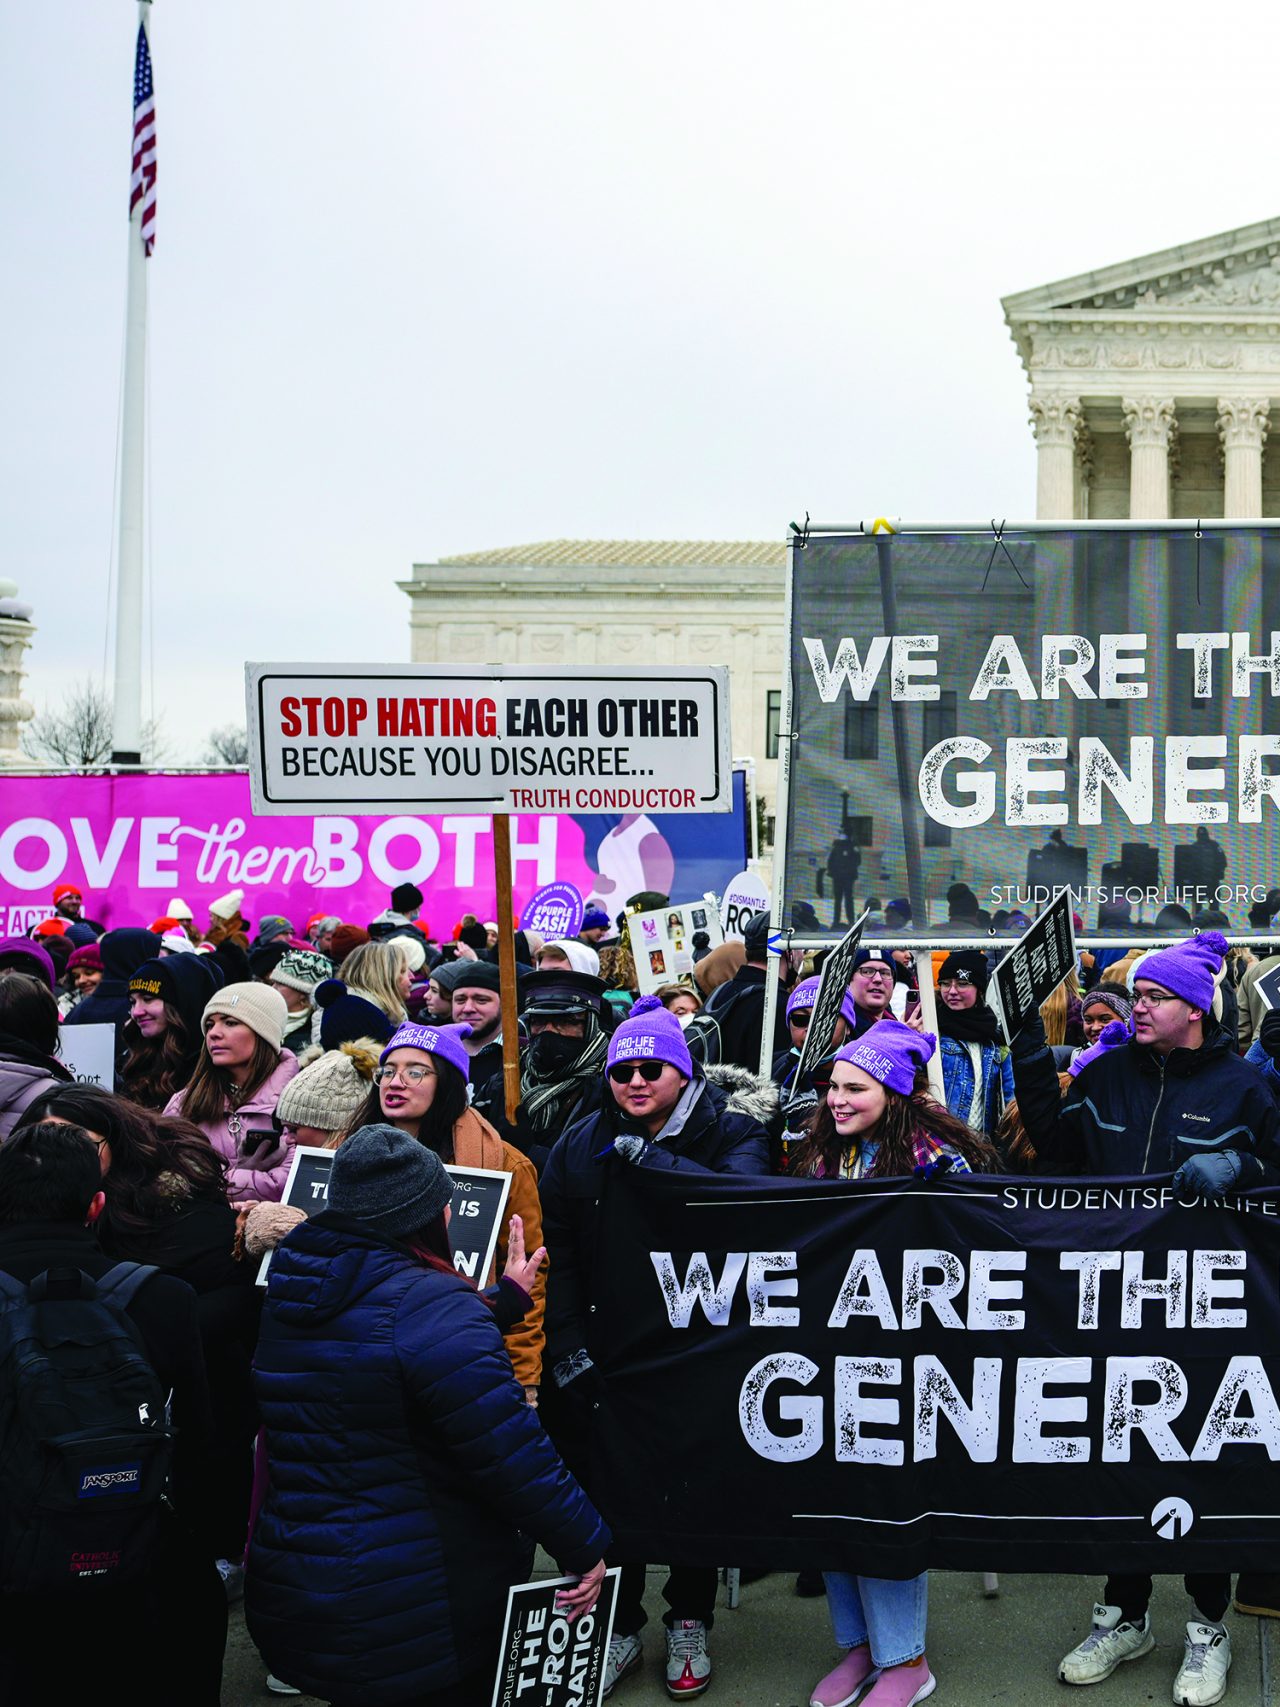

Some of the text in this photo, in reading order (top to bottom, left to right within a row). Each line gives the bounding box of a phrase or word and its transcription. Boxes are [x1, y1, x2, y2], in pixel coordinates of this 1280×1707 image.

[803, 635, 941, 702] WE
[969, 634, 1148, 700] ARE
[280, 697, 698, 737] STOP HATING EACH OTHER
[281, 747, 654, 777] BECAUSE YOU DISAGREE...
[510, 789, 696, 808] TRUTH CONDUCTOR
[169, 817, 327, 885] them
[312, 815, 558, 889] BOTH
[729, 893, 766, 909] #DISMANTLE
[990, 884, 1268, 905] STUDENTSFORLIFE.ORG
[530, 915, 571, 933] SASH
[534, 905, 574, 918] #PURPLE
[1044, 913, 1055, 939] THE
[1030, 942, 1048, 985] ANTI-
[1046, 933, 1060, 970] FUTURE
[794, 989, 817, 1000] PRO-LI
[1011, 944, 1034, 1018] ABORTIO
[395, 1028, 440, 1044] PRO-LIFE
[616, 1036, 655, 1050] PRO-LIFE
[615, 1048, 654, 1059] GENERATION
[850, 1052, 888, 1082] GENERATION
[855, 1045, 895, 1074] PRO-LIFE
[458, 1201, 480, 1218] IS
[650, 1251, 801, 1329] WE
[827, 1249, 1027, 1330] ARE
[1060, 1250, 1247, 1330] THE
[82, 1470, 138, 1490] JANSPORT
[516, 1607, 547, 1699] THE
[591, 1646, 600, 1679] 53445
